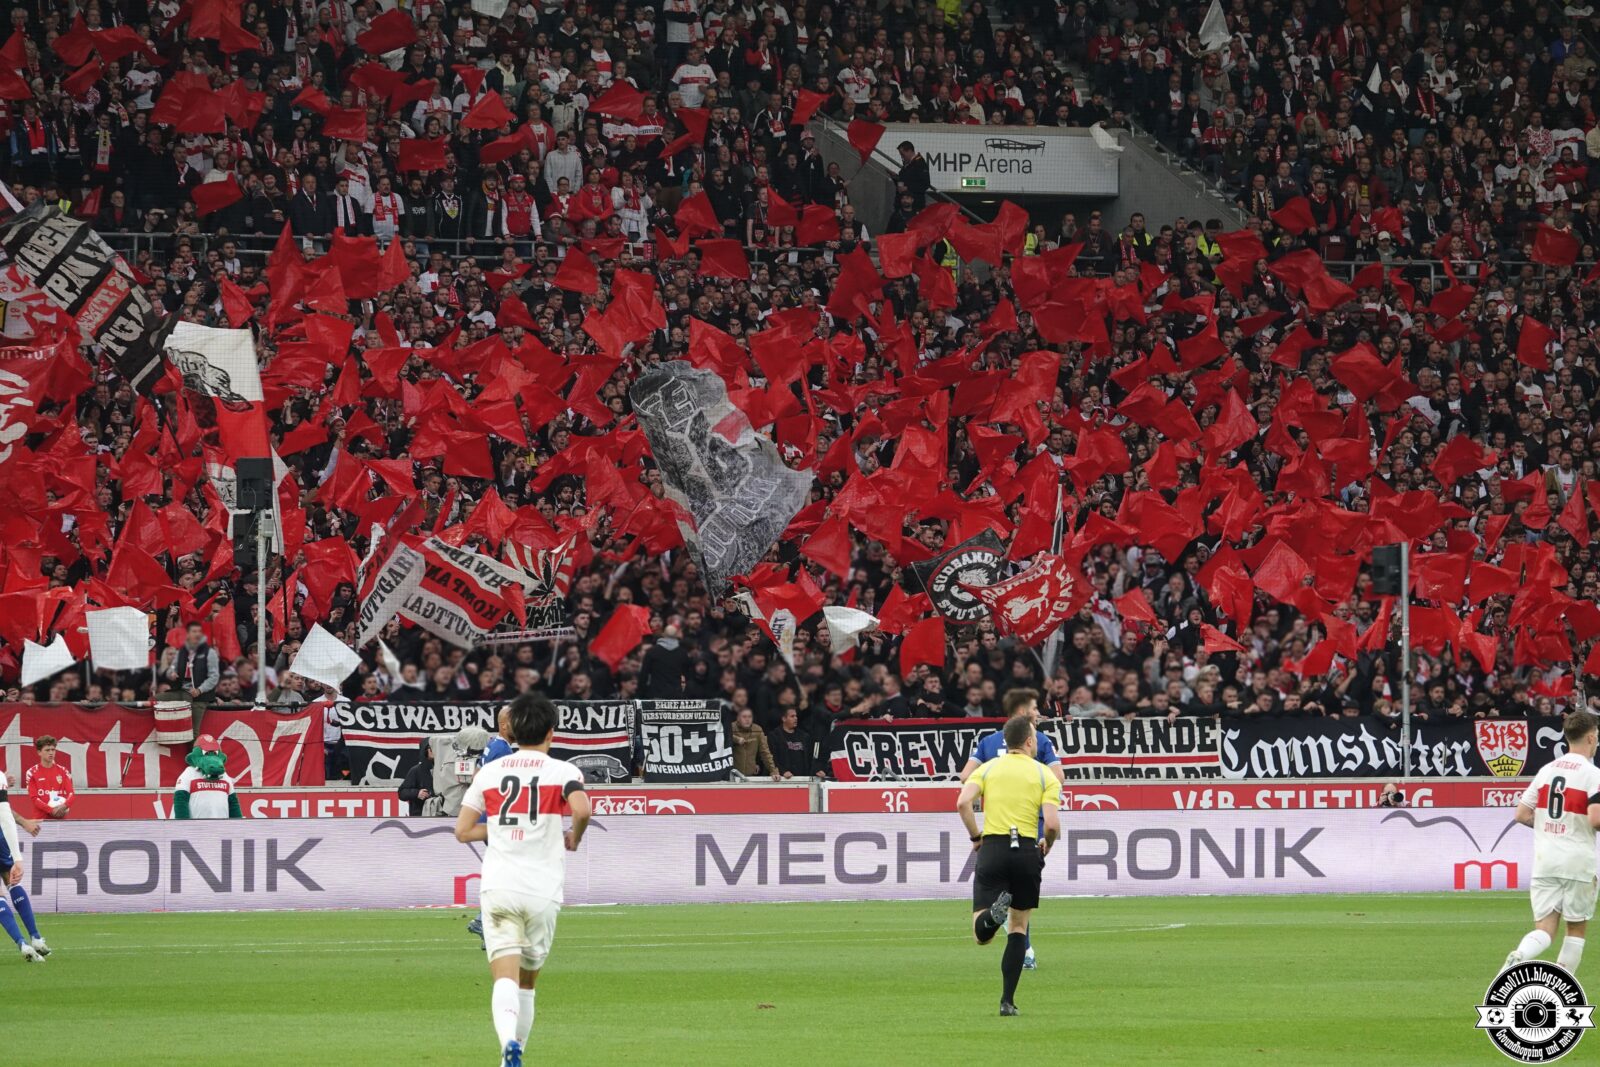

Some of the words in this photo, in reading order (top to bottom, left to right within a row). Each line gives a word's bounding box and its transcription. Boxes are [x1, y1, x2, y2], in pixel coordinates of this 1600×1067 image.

[926, 152, 972, 172] MHP
[974, 154, 1033, 174] Arena
[937, 600, 990, 620] STUTT
[655, 700, 678, 710] EHRE
[679, 700, 707, 709] ALLEN
[335, 702, 497, 731] SCHWABEN
[642, 712, 694, 721] VERSTORBENEN
[694, 712, 720, 720] ULTRAS
[641, 722, 733, 764] 50+1
[501, 758, 545, 769] STUTTGART
[846, 731, 999, 778] CREW
[196, 781, 227, 790] STUTTGART
[499, 775, 540, 826] 21
[881, 791, 909, 813] 36
[1548, 775, 1566, 820] 6
[511, 828, 525, 841] ITO
[20, 837, 326, 896] RONIK
[695, 827, 1326, 886] MECHRONIK
